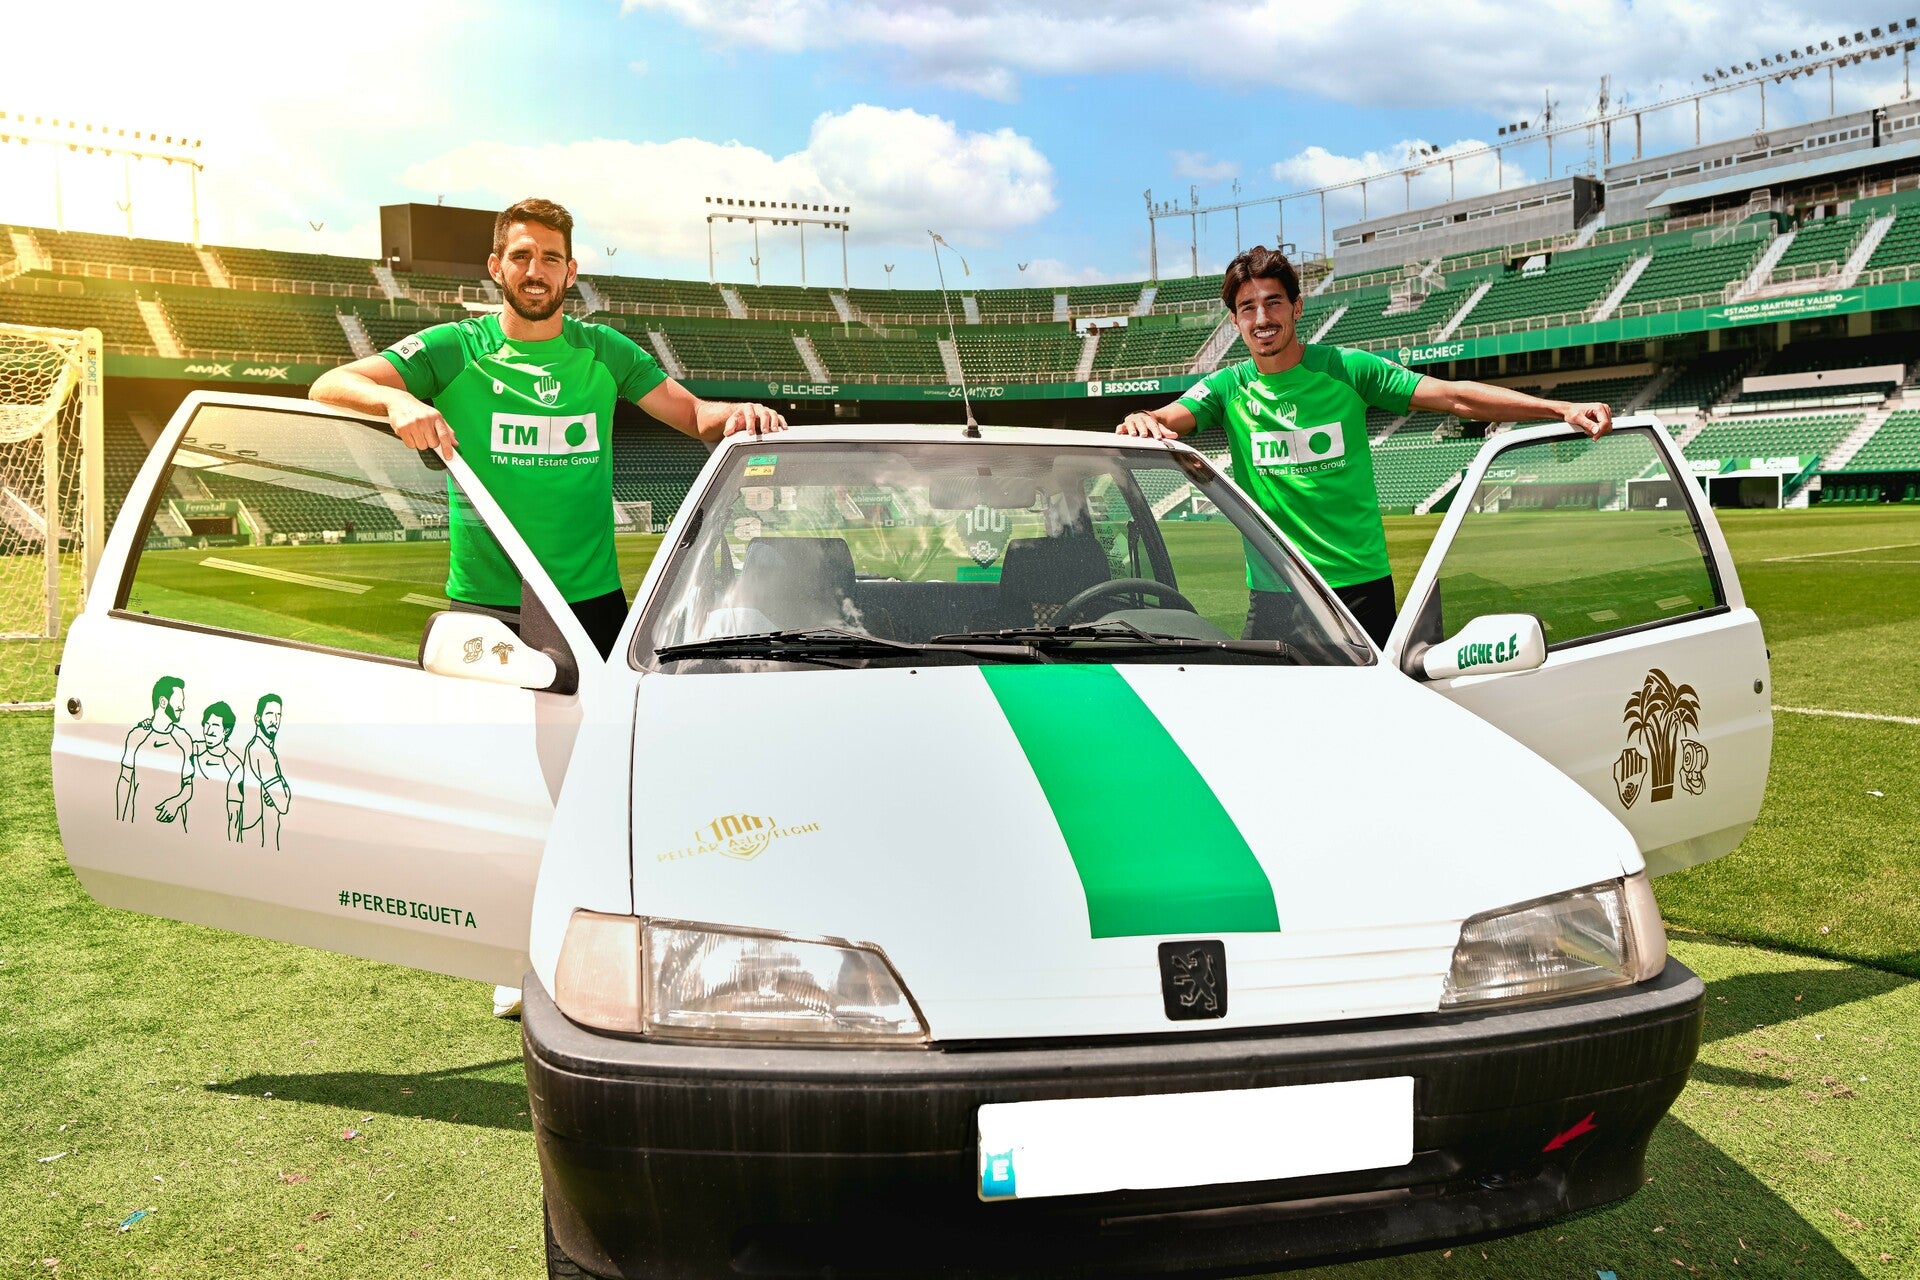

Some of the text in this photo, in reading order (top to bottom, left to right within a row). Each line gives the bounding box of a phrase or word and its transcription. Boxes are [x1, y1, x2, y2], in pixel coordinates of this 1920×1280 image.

[1724, 304, 1759, 316] ESTADIO
[1807, 294, 1843, 305] VALERO
[1412, 344, 1464, 361] ELCHECF
[184, 363, 291, 380] AMIX AMIX
[783, 385, 839, 395] ELCHECF
[1105, 380, 1160, 394] BESOCCER
[499, 424, 538, 446] TM
[1257, 440, 1290, 459] TM
[490, 455, 600, 466] TM Real Estate Group
[1269, 468, 1288, 476] Real
[1290, 465, 1318, 475] Estate
[1320, 459, 1346, 470] Group
[1484, 470, 1516, 478] CHECF
[852, 494, 891, 503] ableworld
[356, 531, 393, 541] PIKOLINOS
[1457, 633, 1520, 670] ELCHE C.F.
[338, 890, 477, 928] #PEREBIGUETA
[992, 1159, 1010, 1181] E
